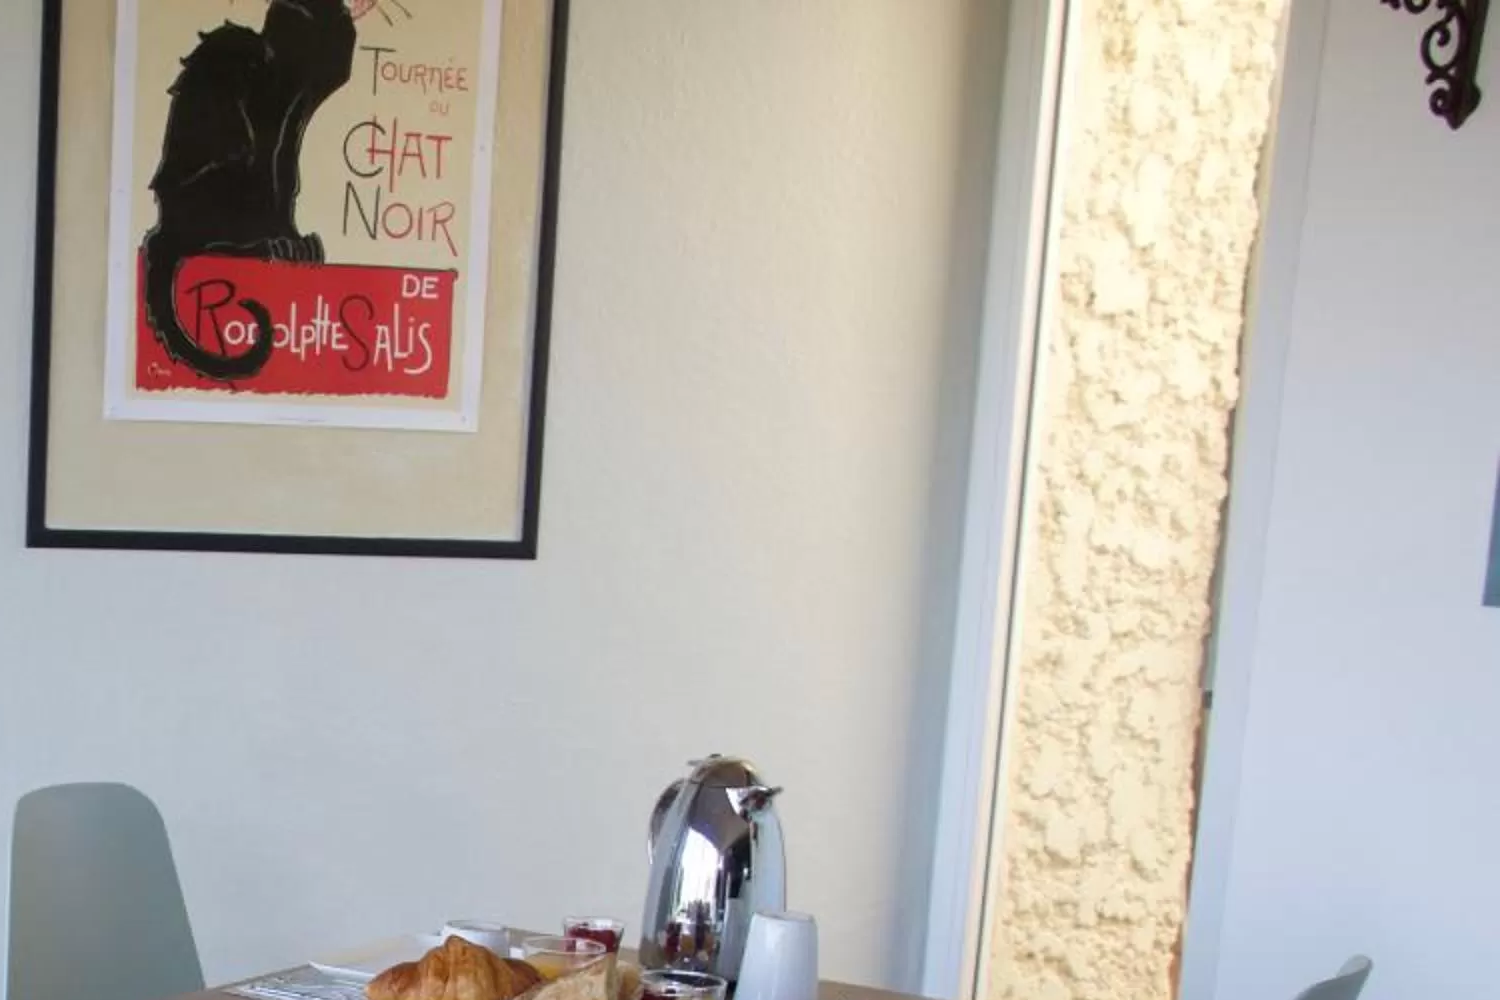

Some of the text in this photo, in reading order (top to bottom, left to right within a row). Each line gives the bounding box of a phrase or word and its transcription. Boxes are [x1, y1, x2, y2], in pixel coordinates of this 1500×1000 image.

[343, 115, 453, 193] CHAT
[343, 180, 458, 257] NOIR
[402, 274, 439, 299] DE
